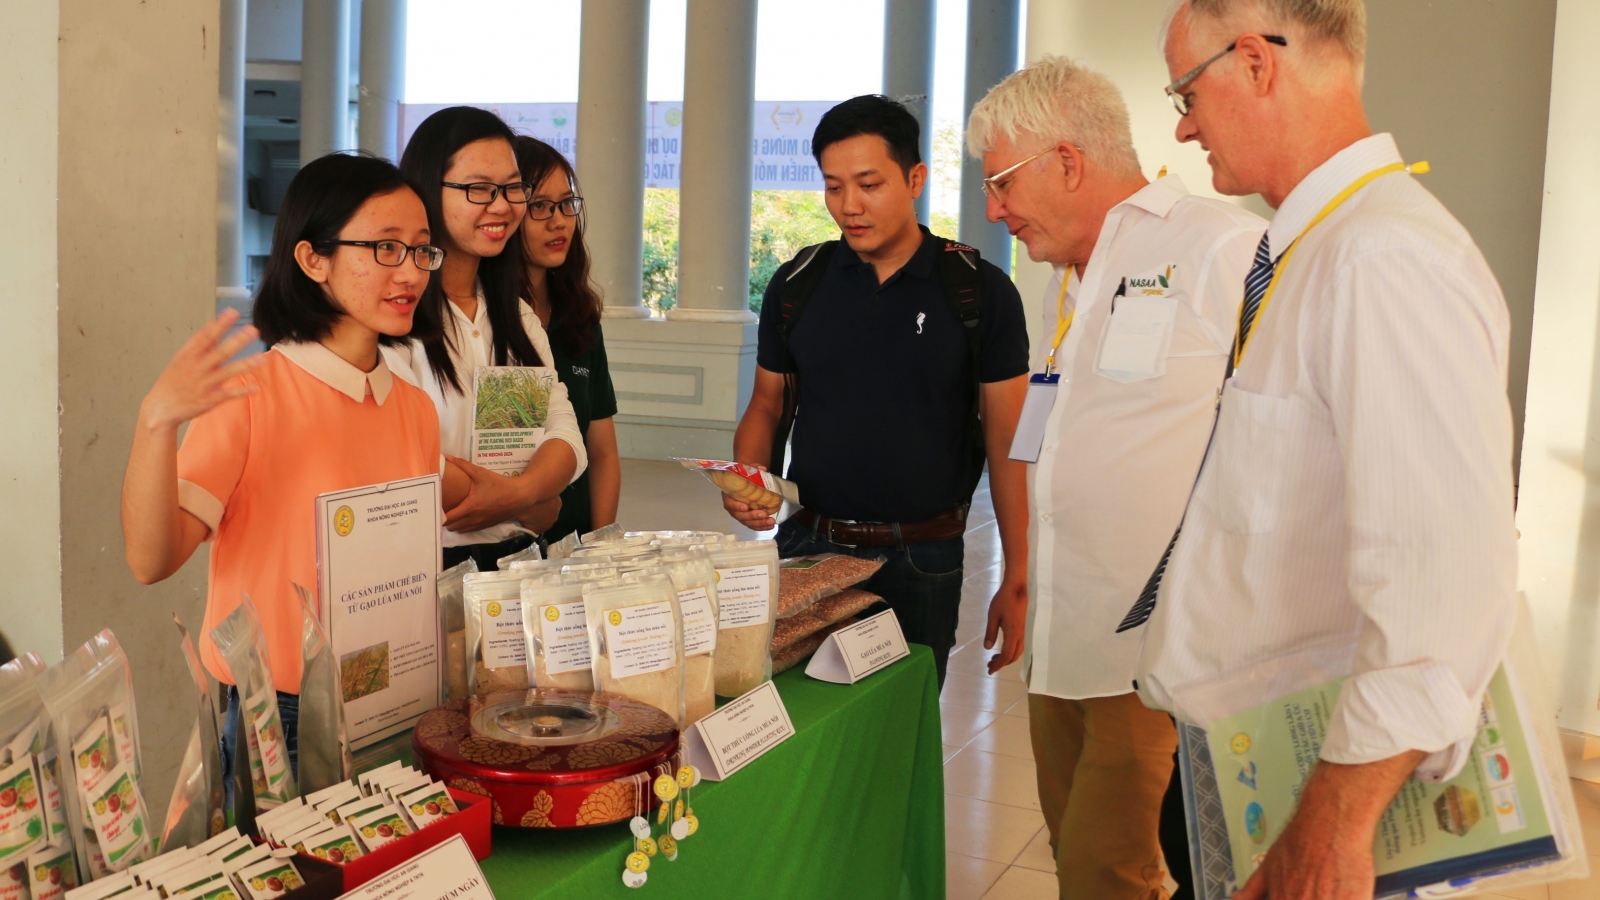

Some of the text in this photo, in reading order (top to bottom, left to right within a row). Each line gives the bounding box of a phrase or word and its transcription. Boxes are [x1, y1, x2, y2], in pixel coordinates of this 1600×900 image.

[1129, 278, 1156, 288] NASAA
[1142, 288, 1164, 296] organic
[341, 590, 357, 602] CÁC
